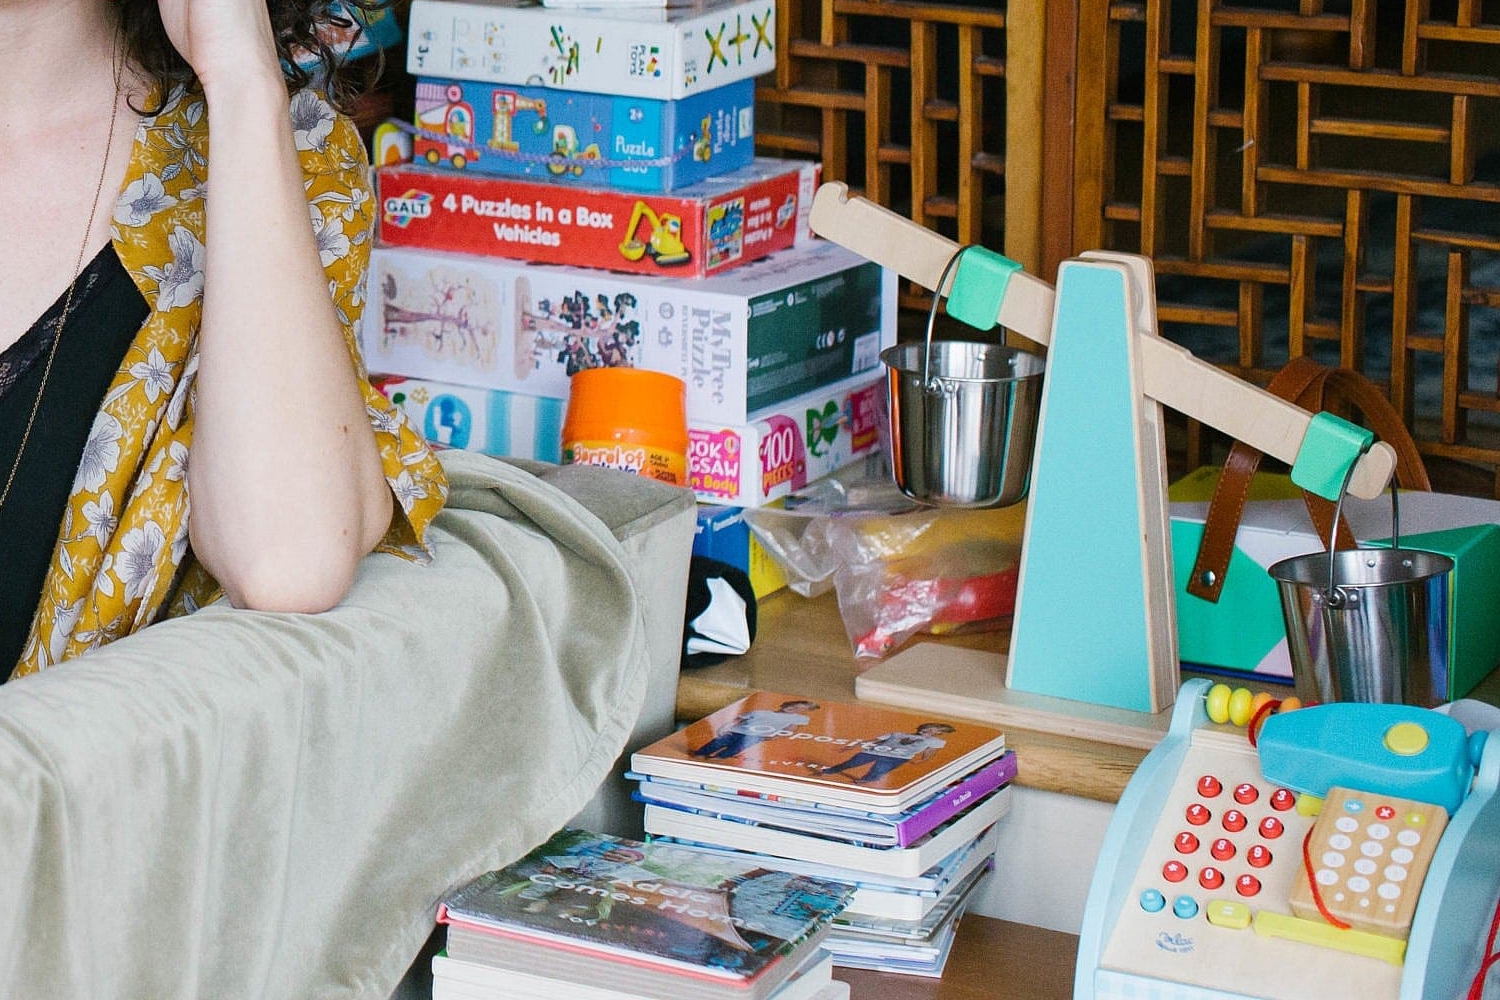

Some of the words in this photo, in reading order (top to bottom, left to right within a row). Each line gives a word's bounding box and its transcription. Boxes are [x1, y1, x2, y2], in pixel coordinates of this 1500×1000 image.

[638, 44, 647, 76] PLAN
[615, 134, 655, 157] Puzzle
[385, 199, 427, 216] GALT
[442, 193, 457, 212] 4
[461, 195, 532, 222] Puzzles
[536, 201, 554, 222] in
[558, 209, 572, 225] a
[576, 206, 614, 229] Box
[493, 223, 561, 247] Vehicles
[691, 307, 711, 388] Puzzle
[623, 448, 645, 470] of
[763, 427, 794, 472] 100
[691, 456, 739, 478] GSAW
[750, 724, 908, 756] Opposites
[1205, 777, 1212, 787] 1
[1238, 784, 1250, 794] 2
[1277, 790, 1287, 800] 3
[1191, 805, 1201, 815] 4
[1228, 811, 1238, 822] 5
[1265, 818, 1275, 829] 6
[1181, 834, 1189, 844] 7
[1217, 840, 1226, 850] 8
[1254, 847, 1263, 858] 9
[1205, 868, 1214, 879] 0
[609, 877, 715, 902] Adela
[529, 873, 649, 905] Comes
[657, 899, 767, 931] Home
